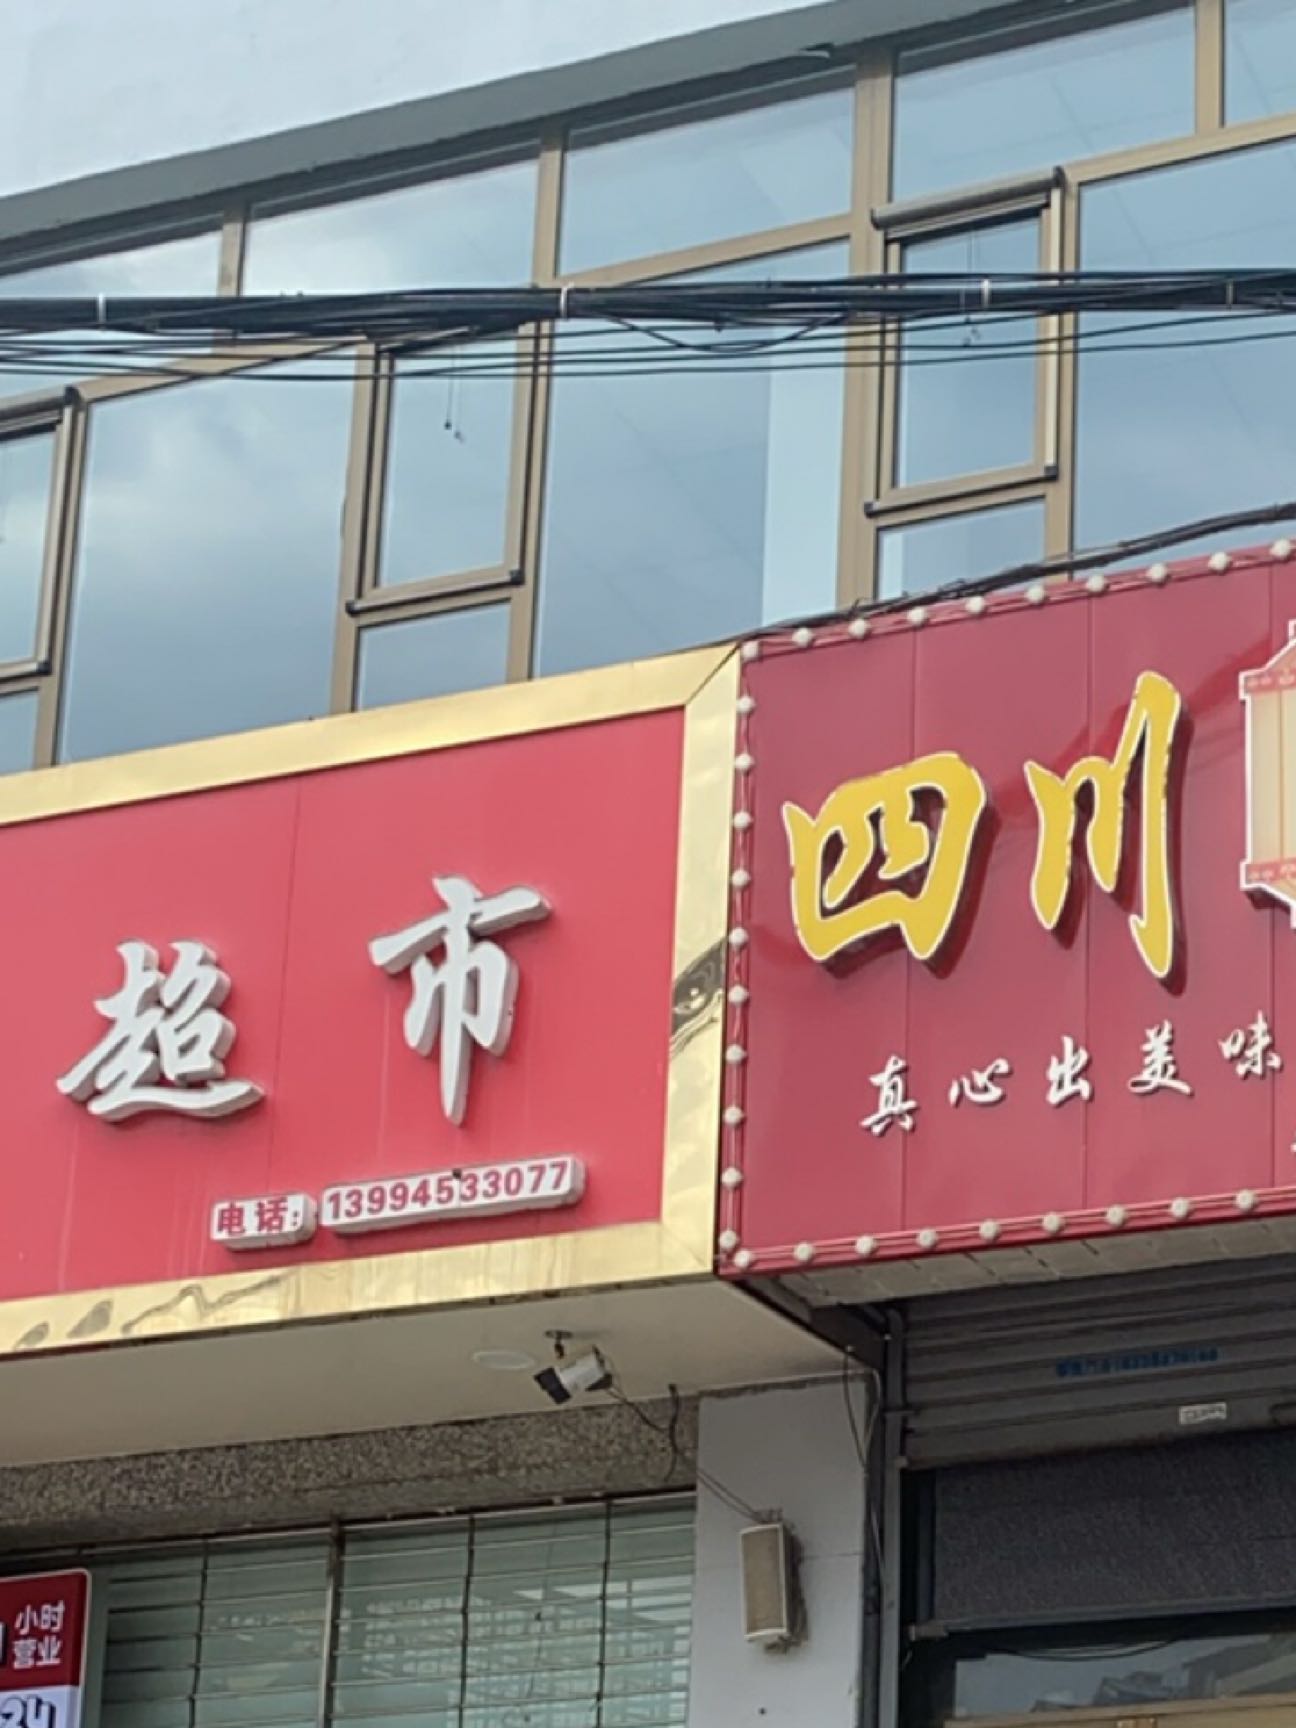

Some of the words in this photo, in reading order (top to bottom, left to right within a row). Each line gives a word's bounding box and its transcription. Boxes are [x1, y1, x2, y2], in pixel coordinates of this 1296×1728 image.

[782, 672, 1184, 982] 四川
[56, 873, 553, 1126] 超市
[860, 1010, 1283, 1137] 真心出美味
[329, 1160, 569, 1219] 13994533077
[13, 1635, 62, 1669] 营业
[14, 1600, 65, 1635] 小时
